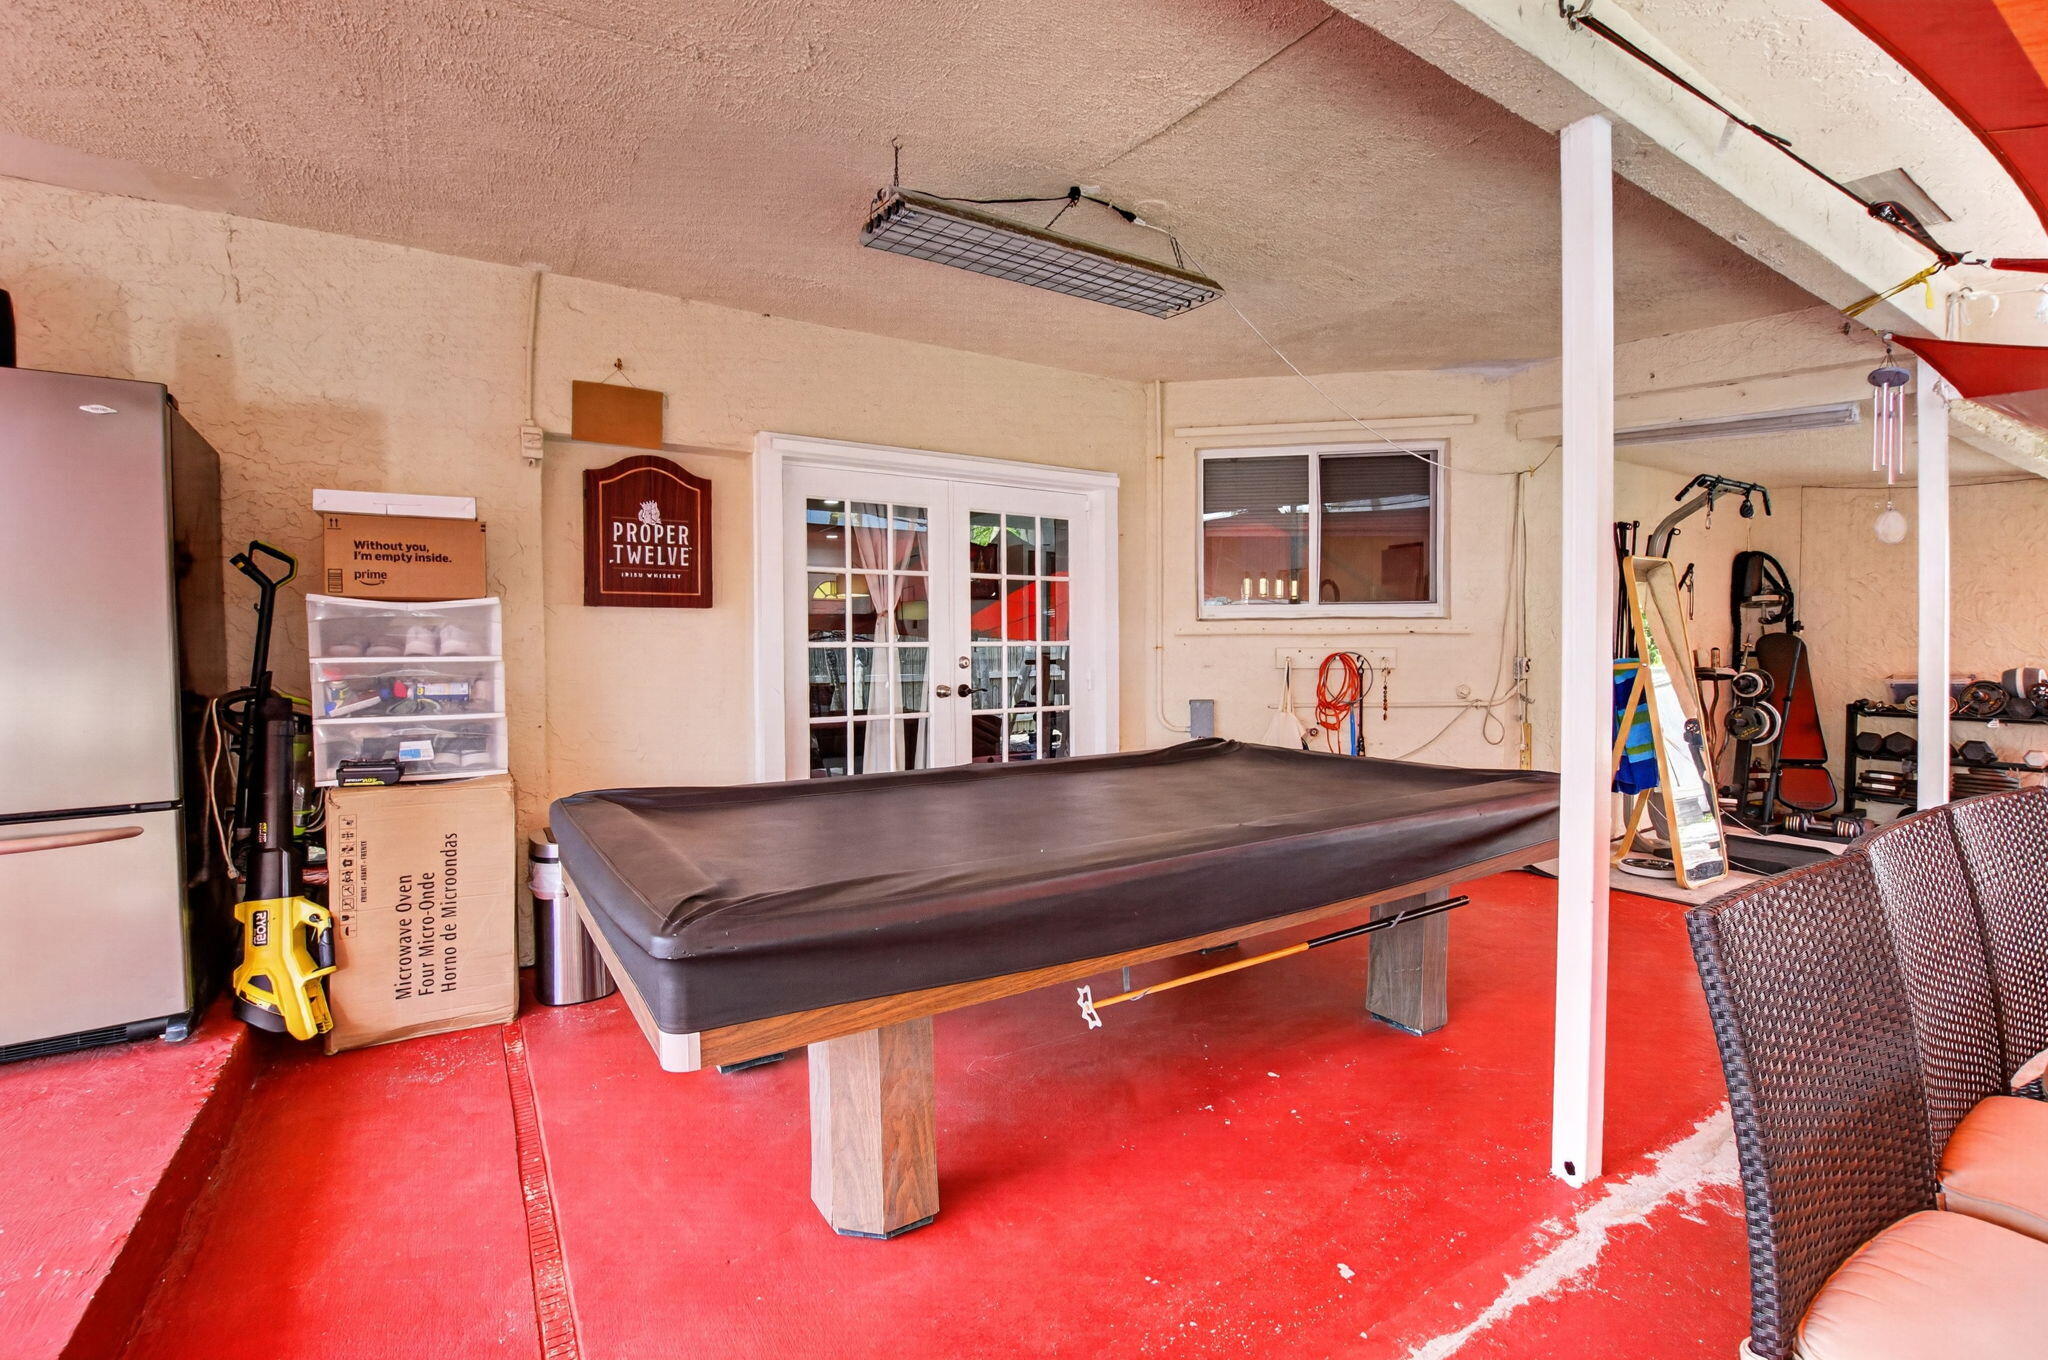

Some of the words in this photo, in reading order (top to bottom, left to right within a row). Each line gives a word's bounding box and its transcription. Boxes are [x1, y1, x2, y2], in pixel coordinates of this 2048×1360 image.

[353, 540, 404, 551] Without
[405, 543, 430, 553] you,
[613, 521, 689, 545] PROPER
[353, 551, 372, 561] I'm
[375, 552, 412, 563] empty
[414, 552, 452, 563] inside.
[612, 544, 689, 566] TWELVE
[354, 569, 388, 580] prime
[440, 832, 458, 918] Microondas
[395, 874, 412, 912] Oven
[255, 911, 267, 945] RYOBI
[417, 872, 435, 957] Micro-Onde
[440, 923, 457, 941] de
[394, 918, 412, 1000] Microwave
[441, 946, 457, 993] Horno
[418, 962, 435, 996] Four
